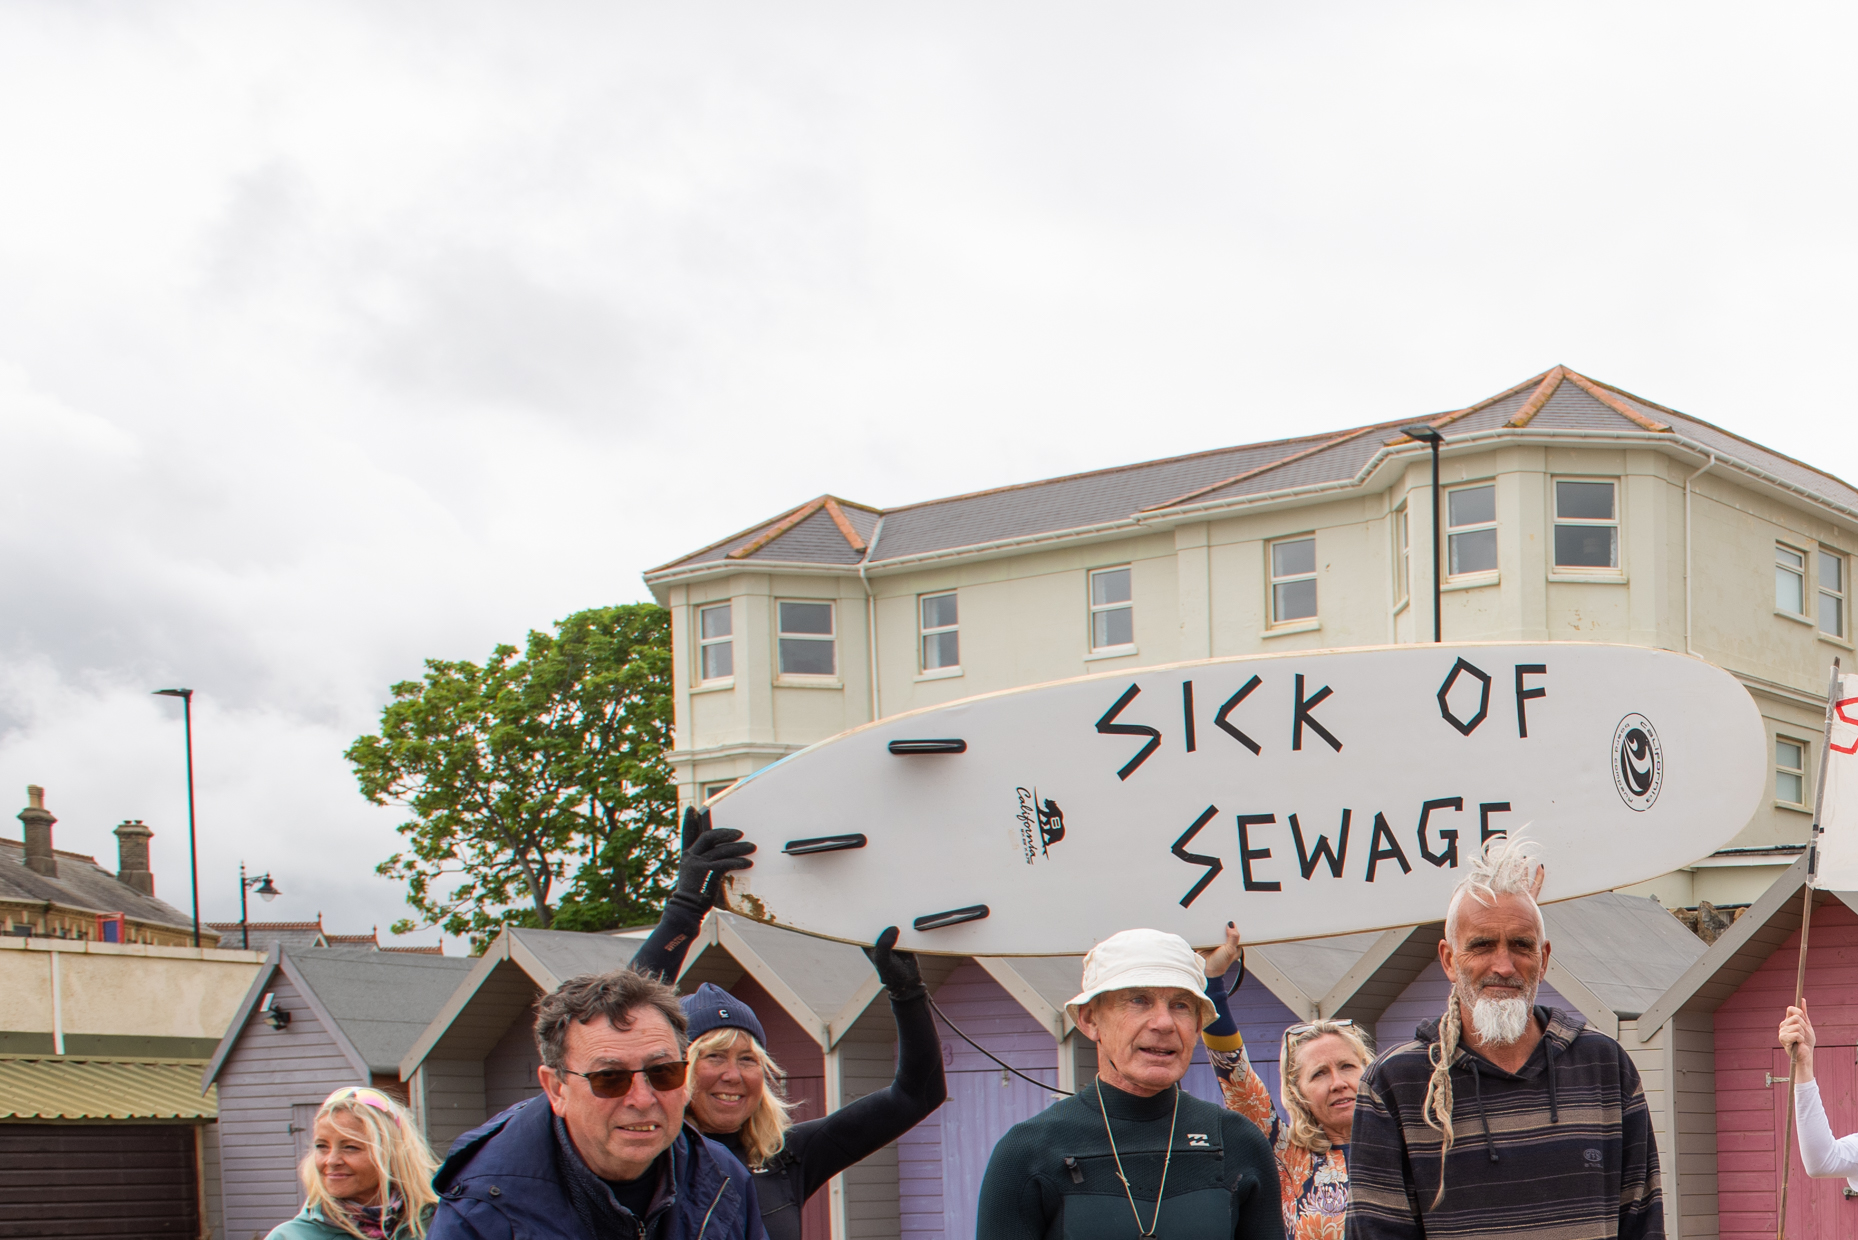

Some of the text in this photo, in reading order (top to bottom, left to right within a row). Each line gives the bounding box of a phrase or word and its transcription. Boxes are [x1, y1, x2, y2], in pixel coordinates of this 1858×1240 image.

[1095, 656, 1547, 782] SICK OF
[1016, 787, 1038, 865] California
[1171, 796, 1512, 909] SEWAGE
